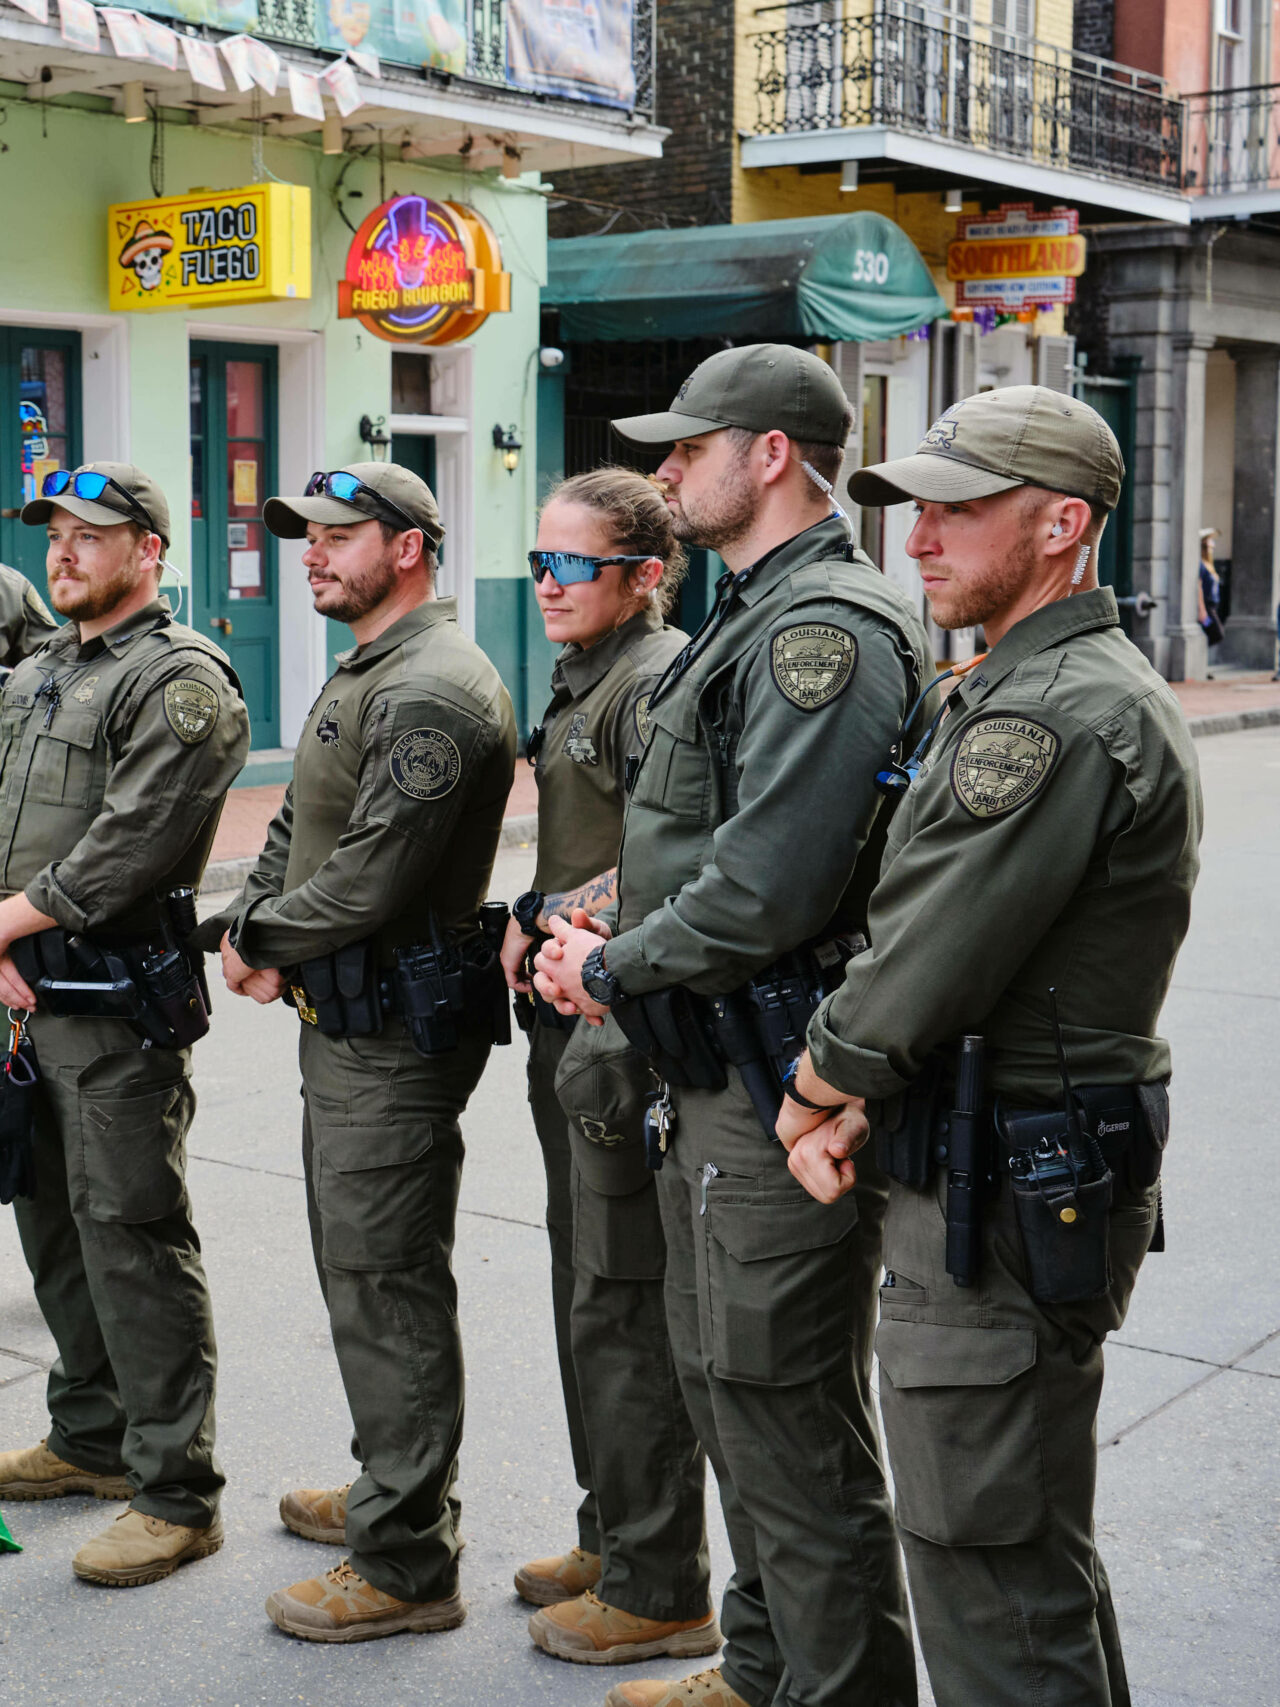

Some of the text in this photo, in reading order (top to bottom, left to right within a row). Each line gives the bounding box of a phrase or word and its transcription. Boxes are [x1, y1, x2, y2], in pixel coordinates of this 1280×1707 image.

[181, 202, 257, 246] TACO
[180, 243, 260, 286] FUEGO
[852, 249, 889, 285] 530
[949, 242, 1080, 276] SOUTHLAND
[352, 282, 470, 309] FUEGO BOURBON
[783, 628, 845, 643] LOUISIANA
[776, 663, 797, 694] WILDLIFE
[787, 661, 837, 669] ENFORCEMENT
[823, 663, 849, 695] FISHERIES
[174, 682, 214, 700] LOUISIANA
[801, 689, 819, 698] AND
[976, 721, 1046, 745] LOUISIANA
[393, 732, 458, 781] SPECIAL OPERATIONS
[970, 757, 1026, 775] ENFORCEMENT
[401, 780, 431, 797] GROUP
[958, 756, 973, 794] WILDLIFE
[1001, 768, 1041, 806] FISHERIES
[975, 794, 997, 806] AND
